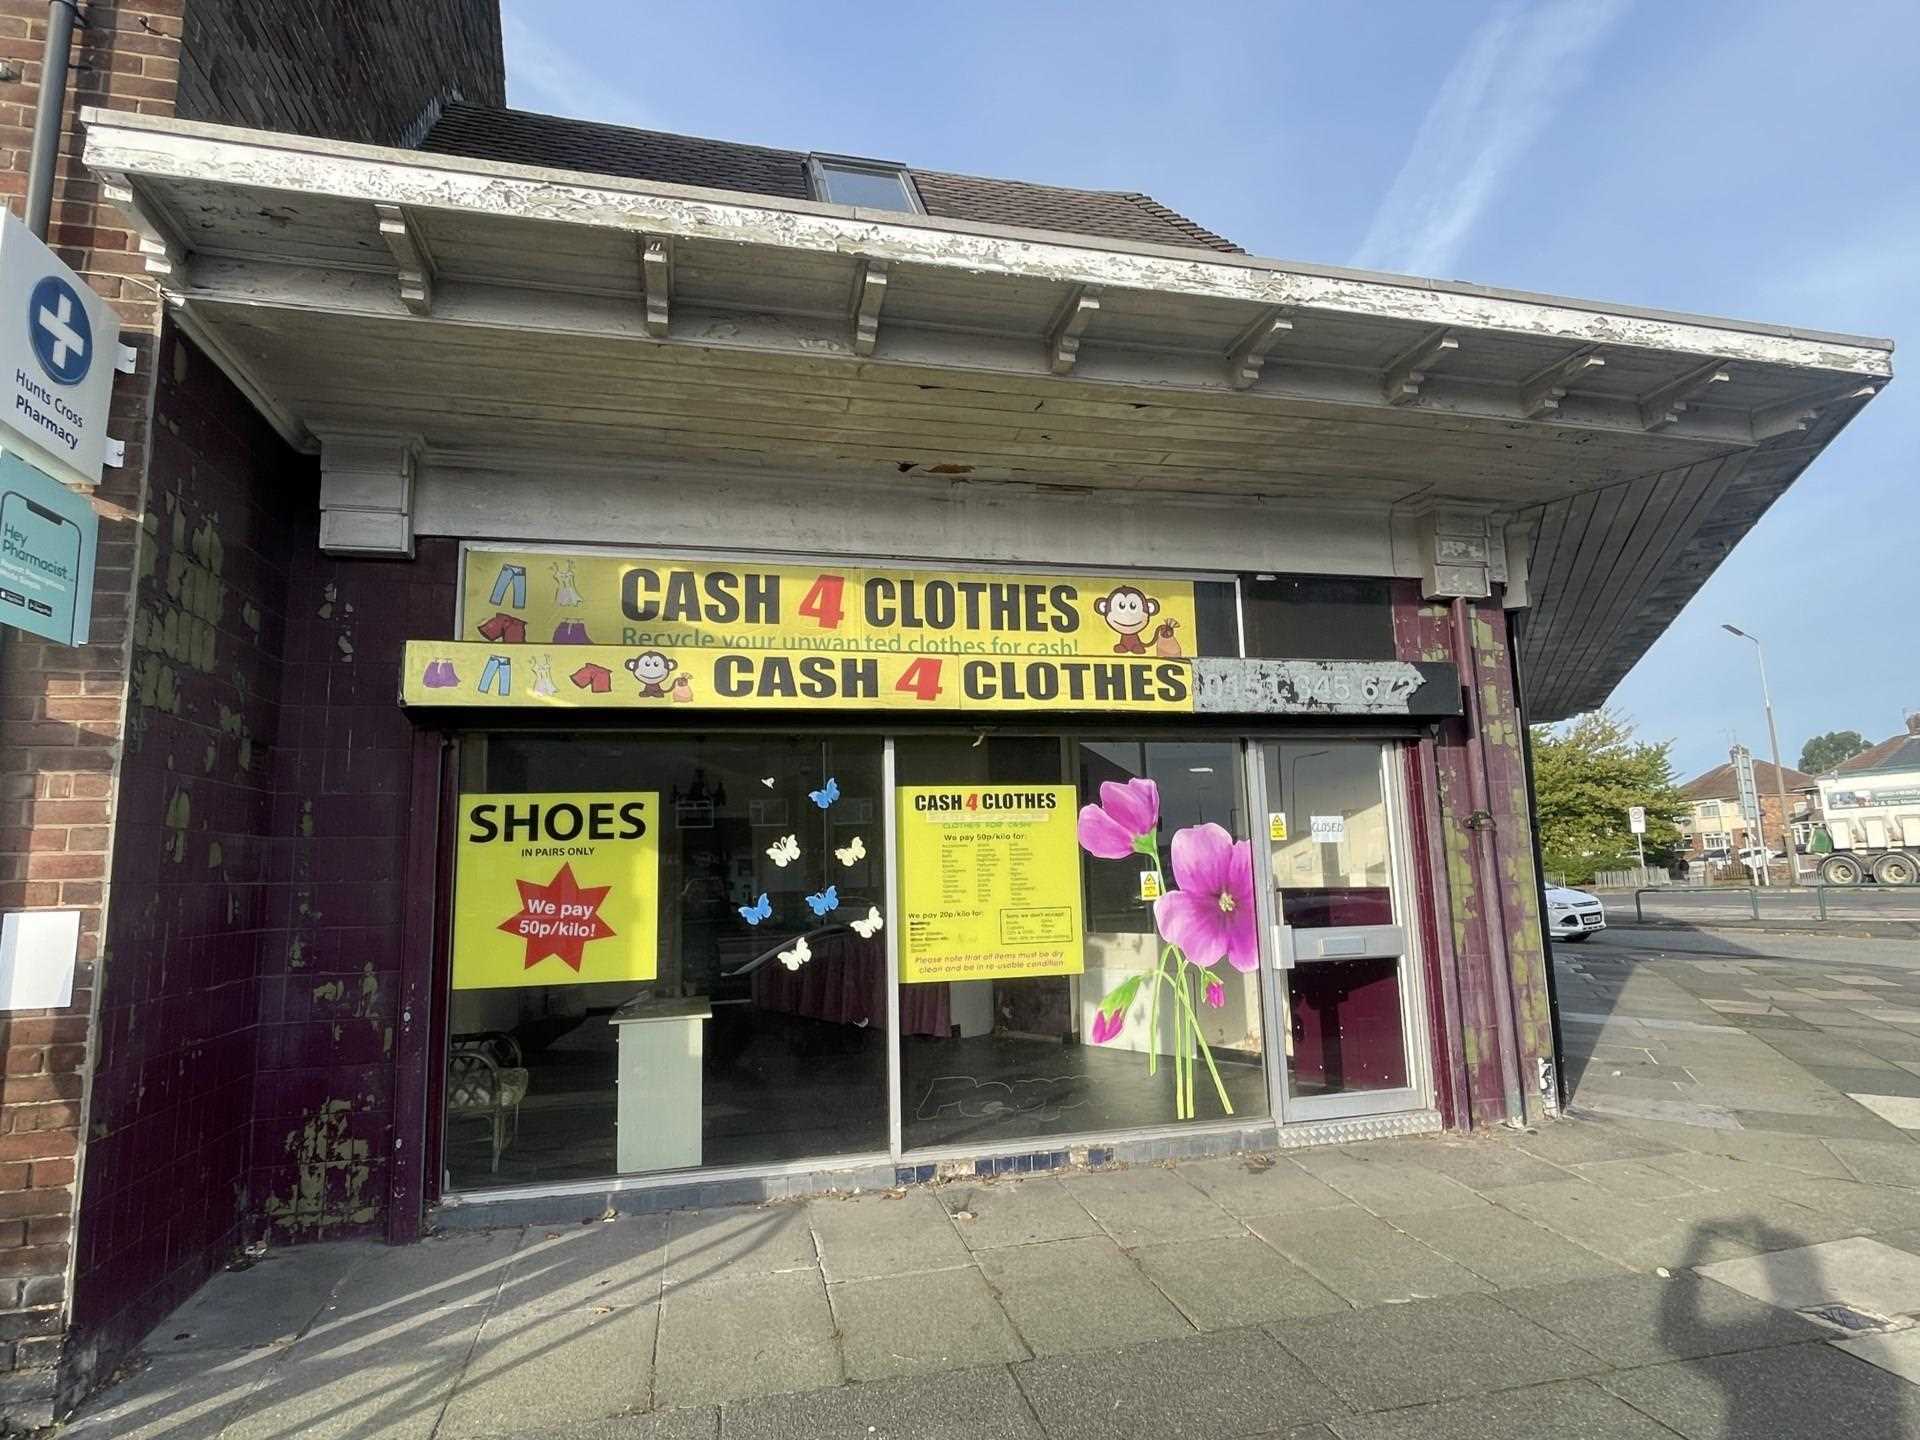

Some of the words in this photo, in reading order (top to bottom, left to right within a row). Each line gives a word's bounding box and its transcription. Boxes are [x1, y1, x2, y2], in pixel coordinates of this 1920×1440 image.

[16, 368, 51, 406] Hunts
[55, 398, 83, 428] Cross
[16, 394, 79, 450] Pharmacy
[4, 523, 28, 548] Hey
[621, 568, 780, 625] CASH
[798, 574, 845, 630] 4
[864, 577, 1080, 634] CLOTHES
[622, 627, 714, 648] Recycle
[908, 634, 985, 654] clothes
[992, 636, 1021, 655] for
[714, 655, 878, 698] CASH
[895, 657, 943, 700] 4
[963, 660, 1187, 703] CLOTHES
[915, 795, 962, 811] CASH
[966, 793, 978, 811] 4
[982, 793, 1056, 809] CLOTHES
[469, 802, 646, 843] SHOES
[1311, 822, 1344, 833] CLOSED
[959, 834, 974, 842] pay
[521, 848, 533, 857] IN
[535, 848, 565, 857] PAIRS
[567, 847, 595, 856] ONLY
[528, 899, 555, 914] We
[560, 904, 593, 920] pay
[519, 919, 595, 937] 50p/kilo!
